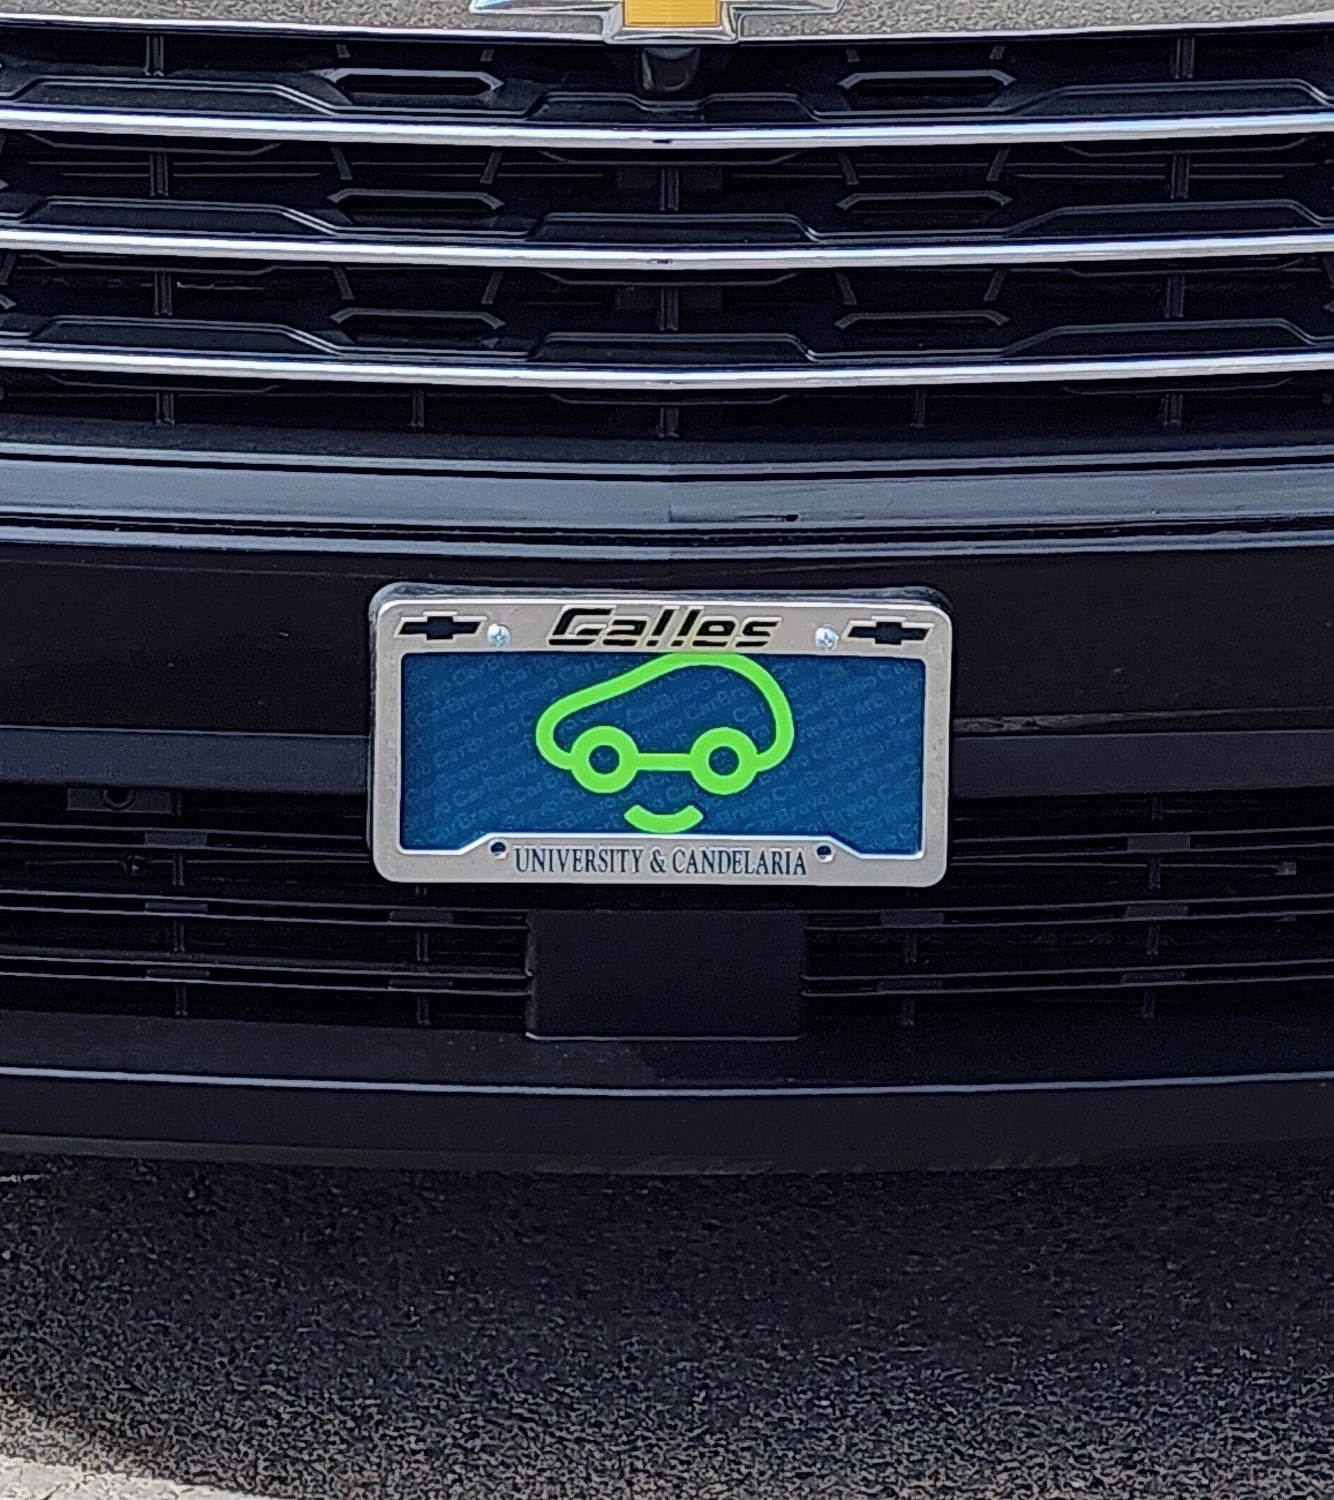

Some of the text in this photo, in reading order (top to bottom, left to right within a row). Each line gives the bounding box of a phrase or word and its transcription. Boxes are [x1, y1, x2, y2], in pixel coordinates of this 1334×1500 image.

[547, 605, 784, 648] Galles
[514, 846, 807, 876] UNIVERSITY & CANDELARIA
